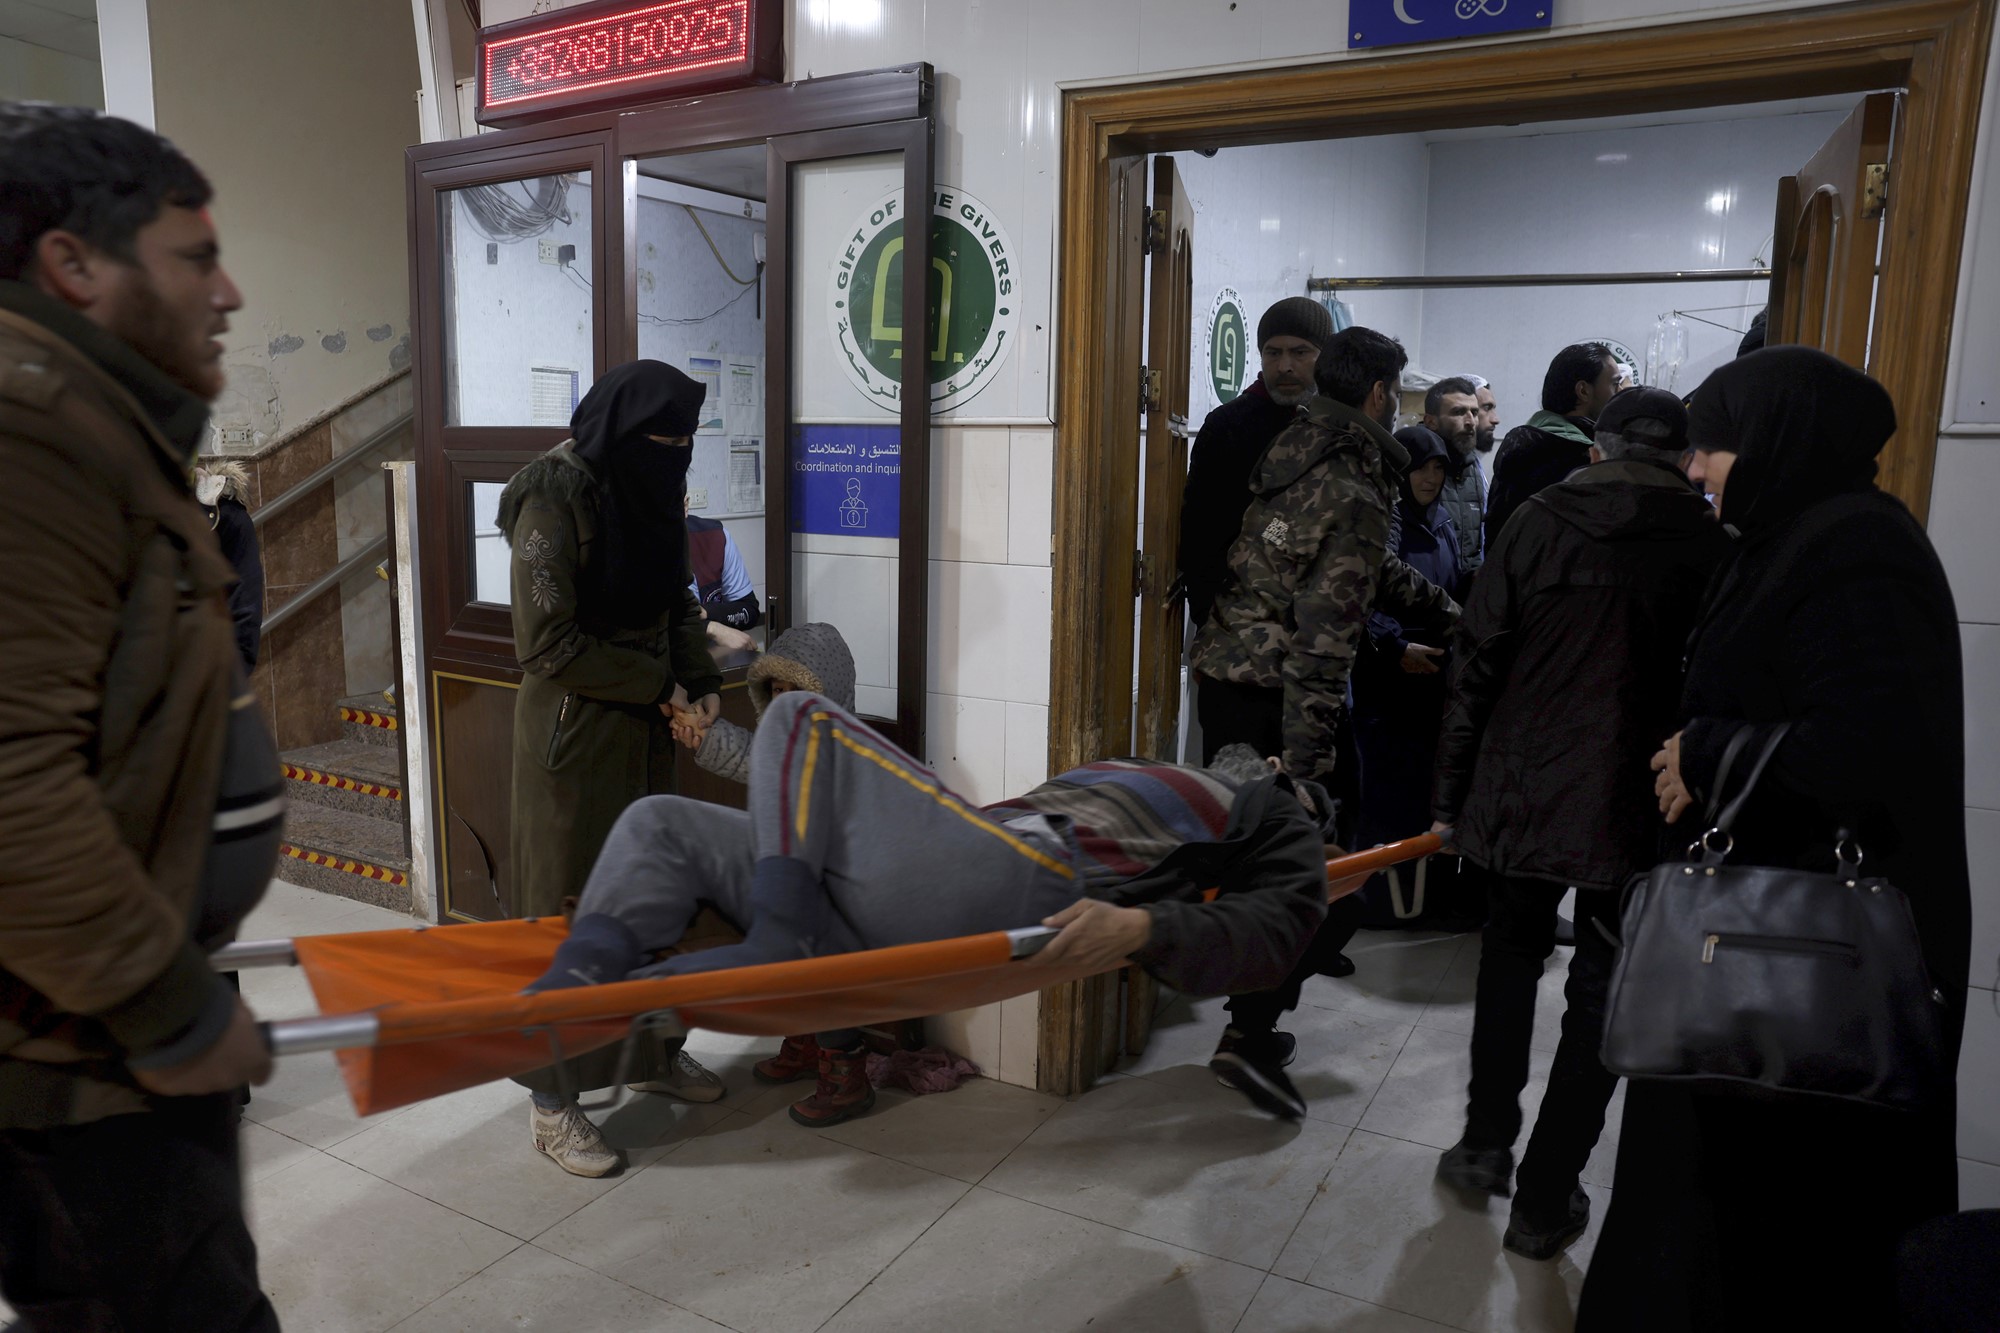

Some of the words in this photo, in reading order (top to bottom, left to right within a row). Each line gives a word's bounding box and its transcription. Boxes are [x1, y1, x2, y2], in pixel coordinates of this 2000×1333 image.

[870, 199, 897, 226] OF
[1216, 290, 1224, 306] OF
[1225, 288, 1237, 301] THE
[807, 442, 856, 455] الاستعلامات
[859, 447, 866, 458] و
[794, 460, 853, 474] Coordination
[855, 462, 873, 474] and
